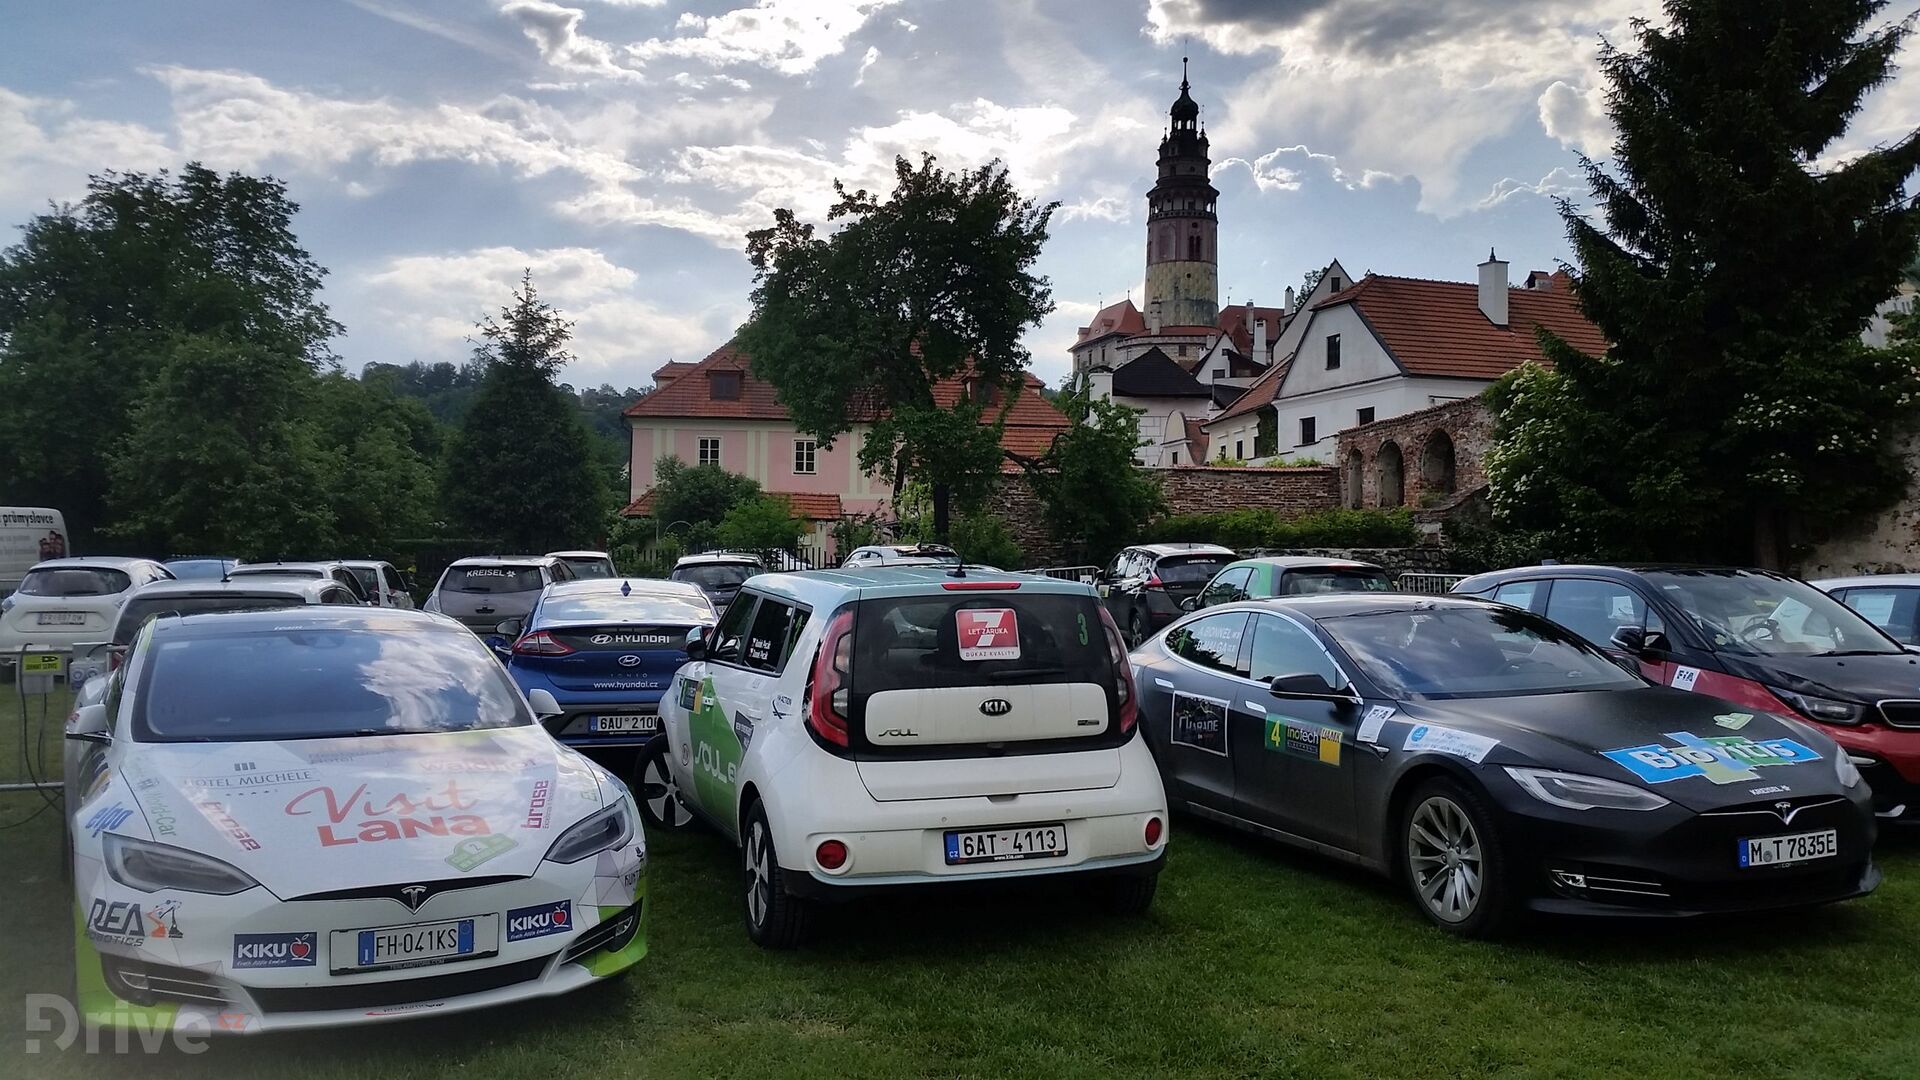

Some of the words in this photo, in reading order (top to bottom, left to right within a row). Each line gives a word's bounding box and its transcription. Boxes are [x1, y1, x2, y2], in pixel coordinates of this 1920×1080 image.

[466, 569, 505, 578] KREISEL
[615, 634, 670, 644] HYUNDAI
[1077, 613, 1089, 646] 3
[984, 701, 1008, 713] KIA
[600, 717, 623, 730] 6AU
[1271, 720, 1281, 747] 4
[1287, 725, 1319, 745] inotech
[239, 771, 312, 786] MUCHELE
[285, 778, 480, 824] Visit
[519, 779, 550, 830] brose
[963, 834, 997, 856] 6AT
[1013, 829, 1056, 852] 4113
[1751, 841, 1762, 862] M
[1773, 840, 1783, 860] T
[1788, 833, 1836, 859] 7835E
[87, 897, 146, 937] REA
[510, 912, 550, 933] KIKU
[237, 942, 288, 959] KIKU
